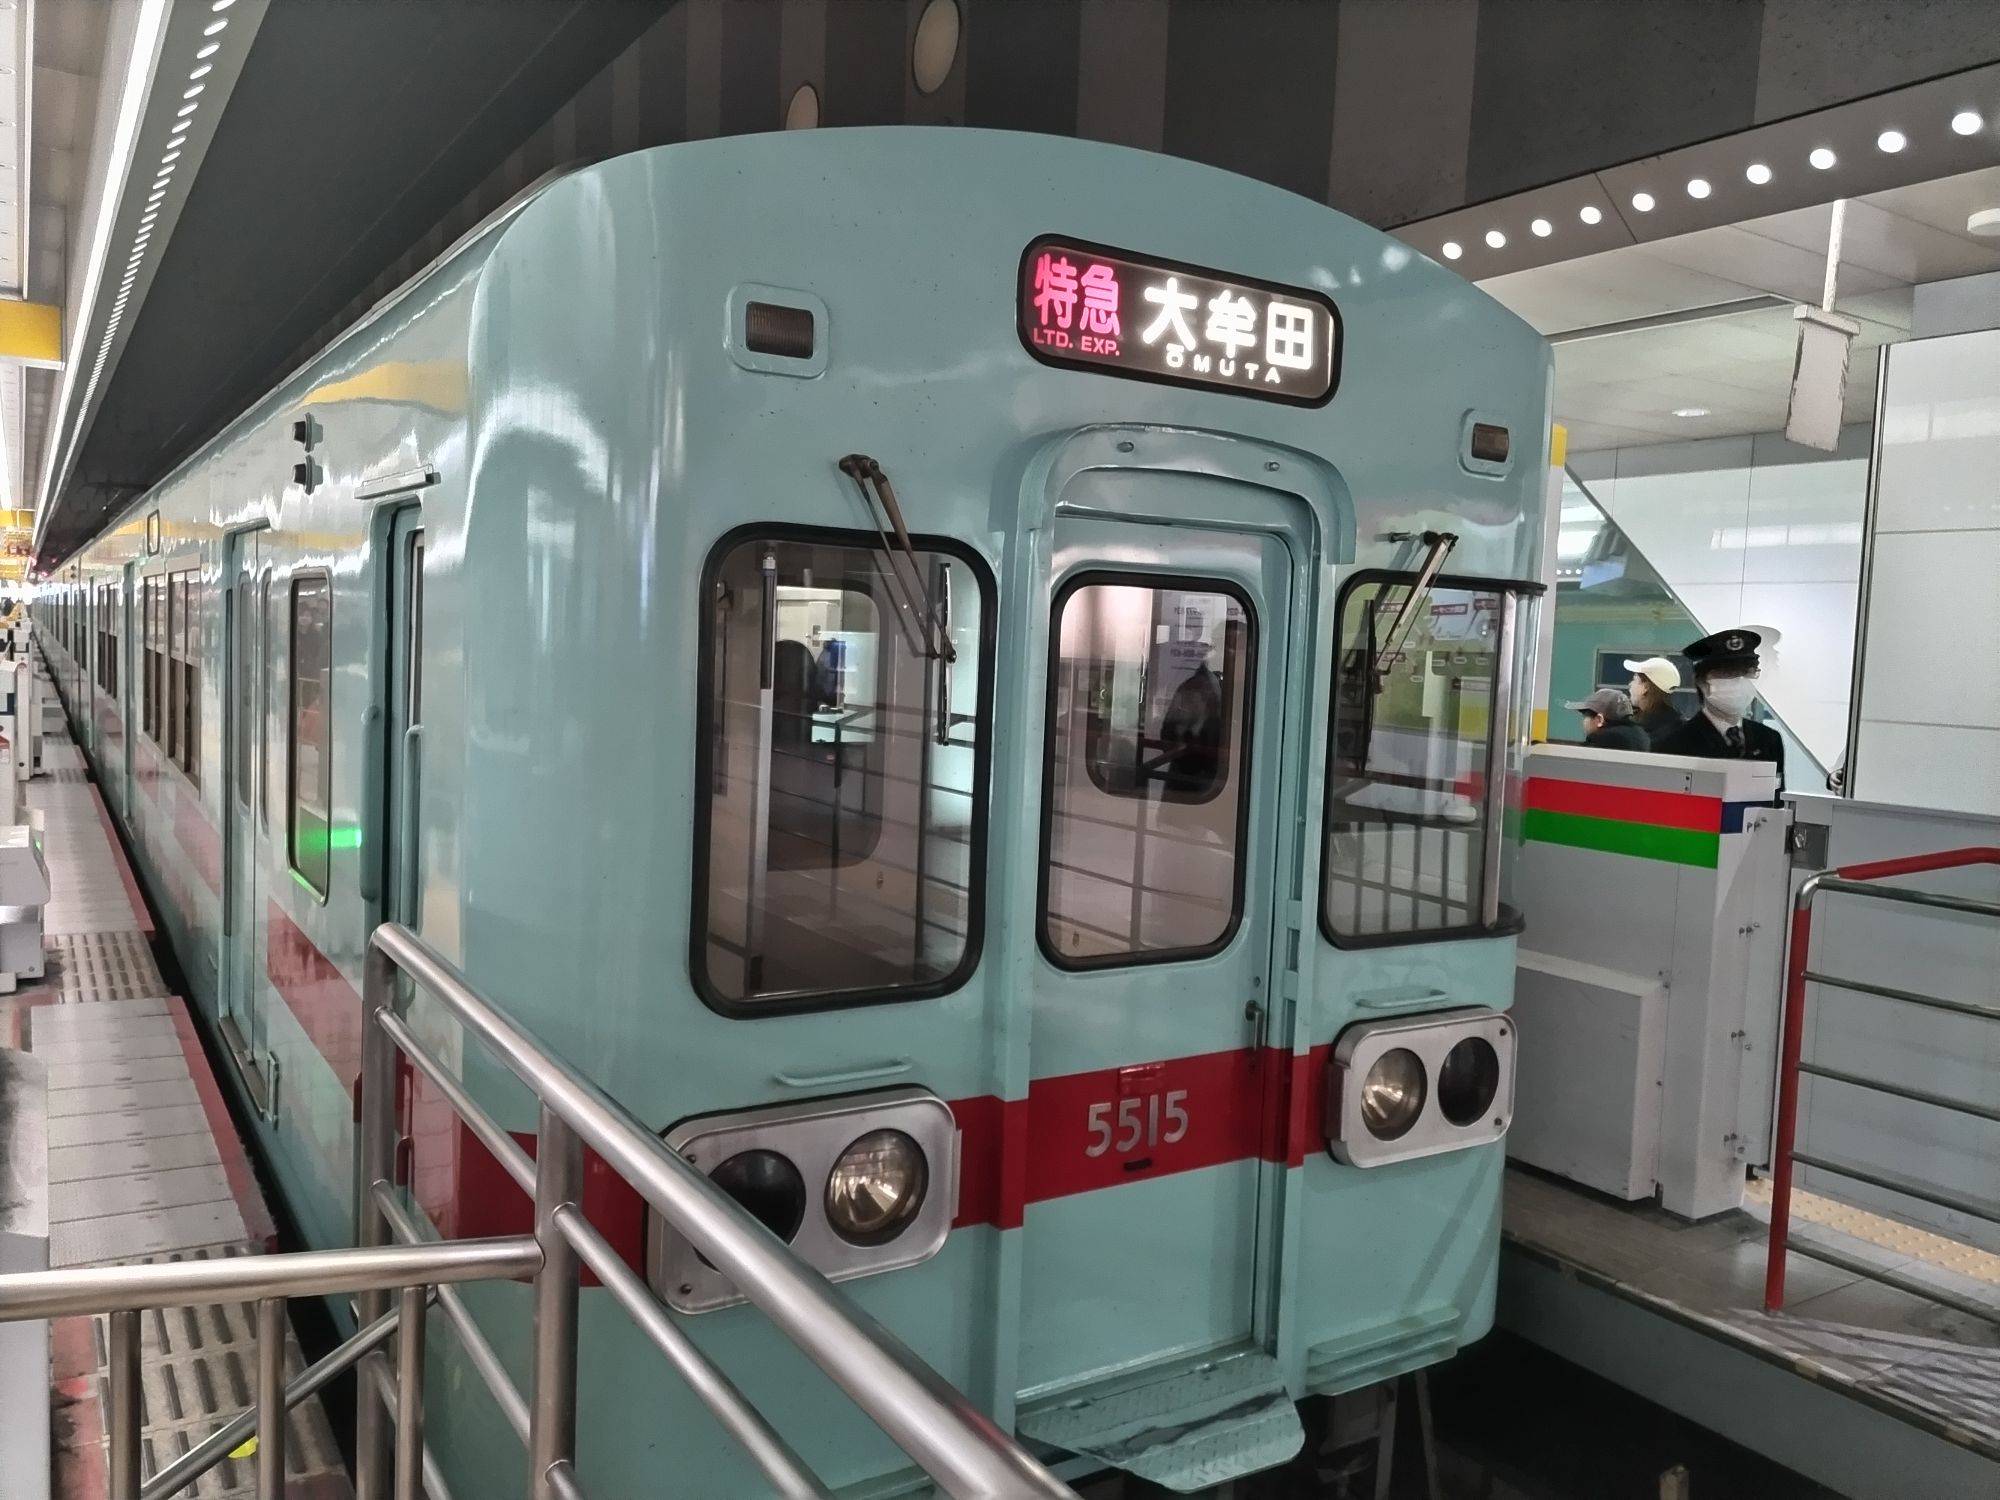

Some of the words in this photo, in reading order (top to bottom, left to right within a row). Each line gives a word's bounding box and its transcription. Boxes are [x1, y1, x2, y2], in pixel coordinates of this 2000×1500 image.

[1033, 253, 1120, 335] 特急
[1142, 277, 1314, 370] 大牟田
[1033, 327, 1074, 349] LTD.
[1081, 335, 1120, 356] EXP.
[1085, 1089, 1189, 1158] 5515
